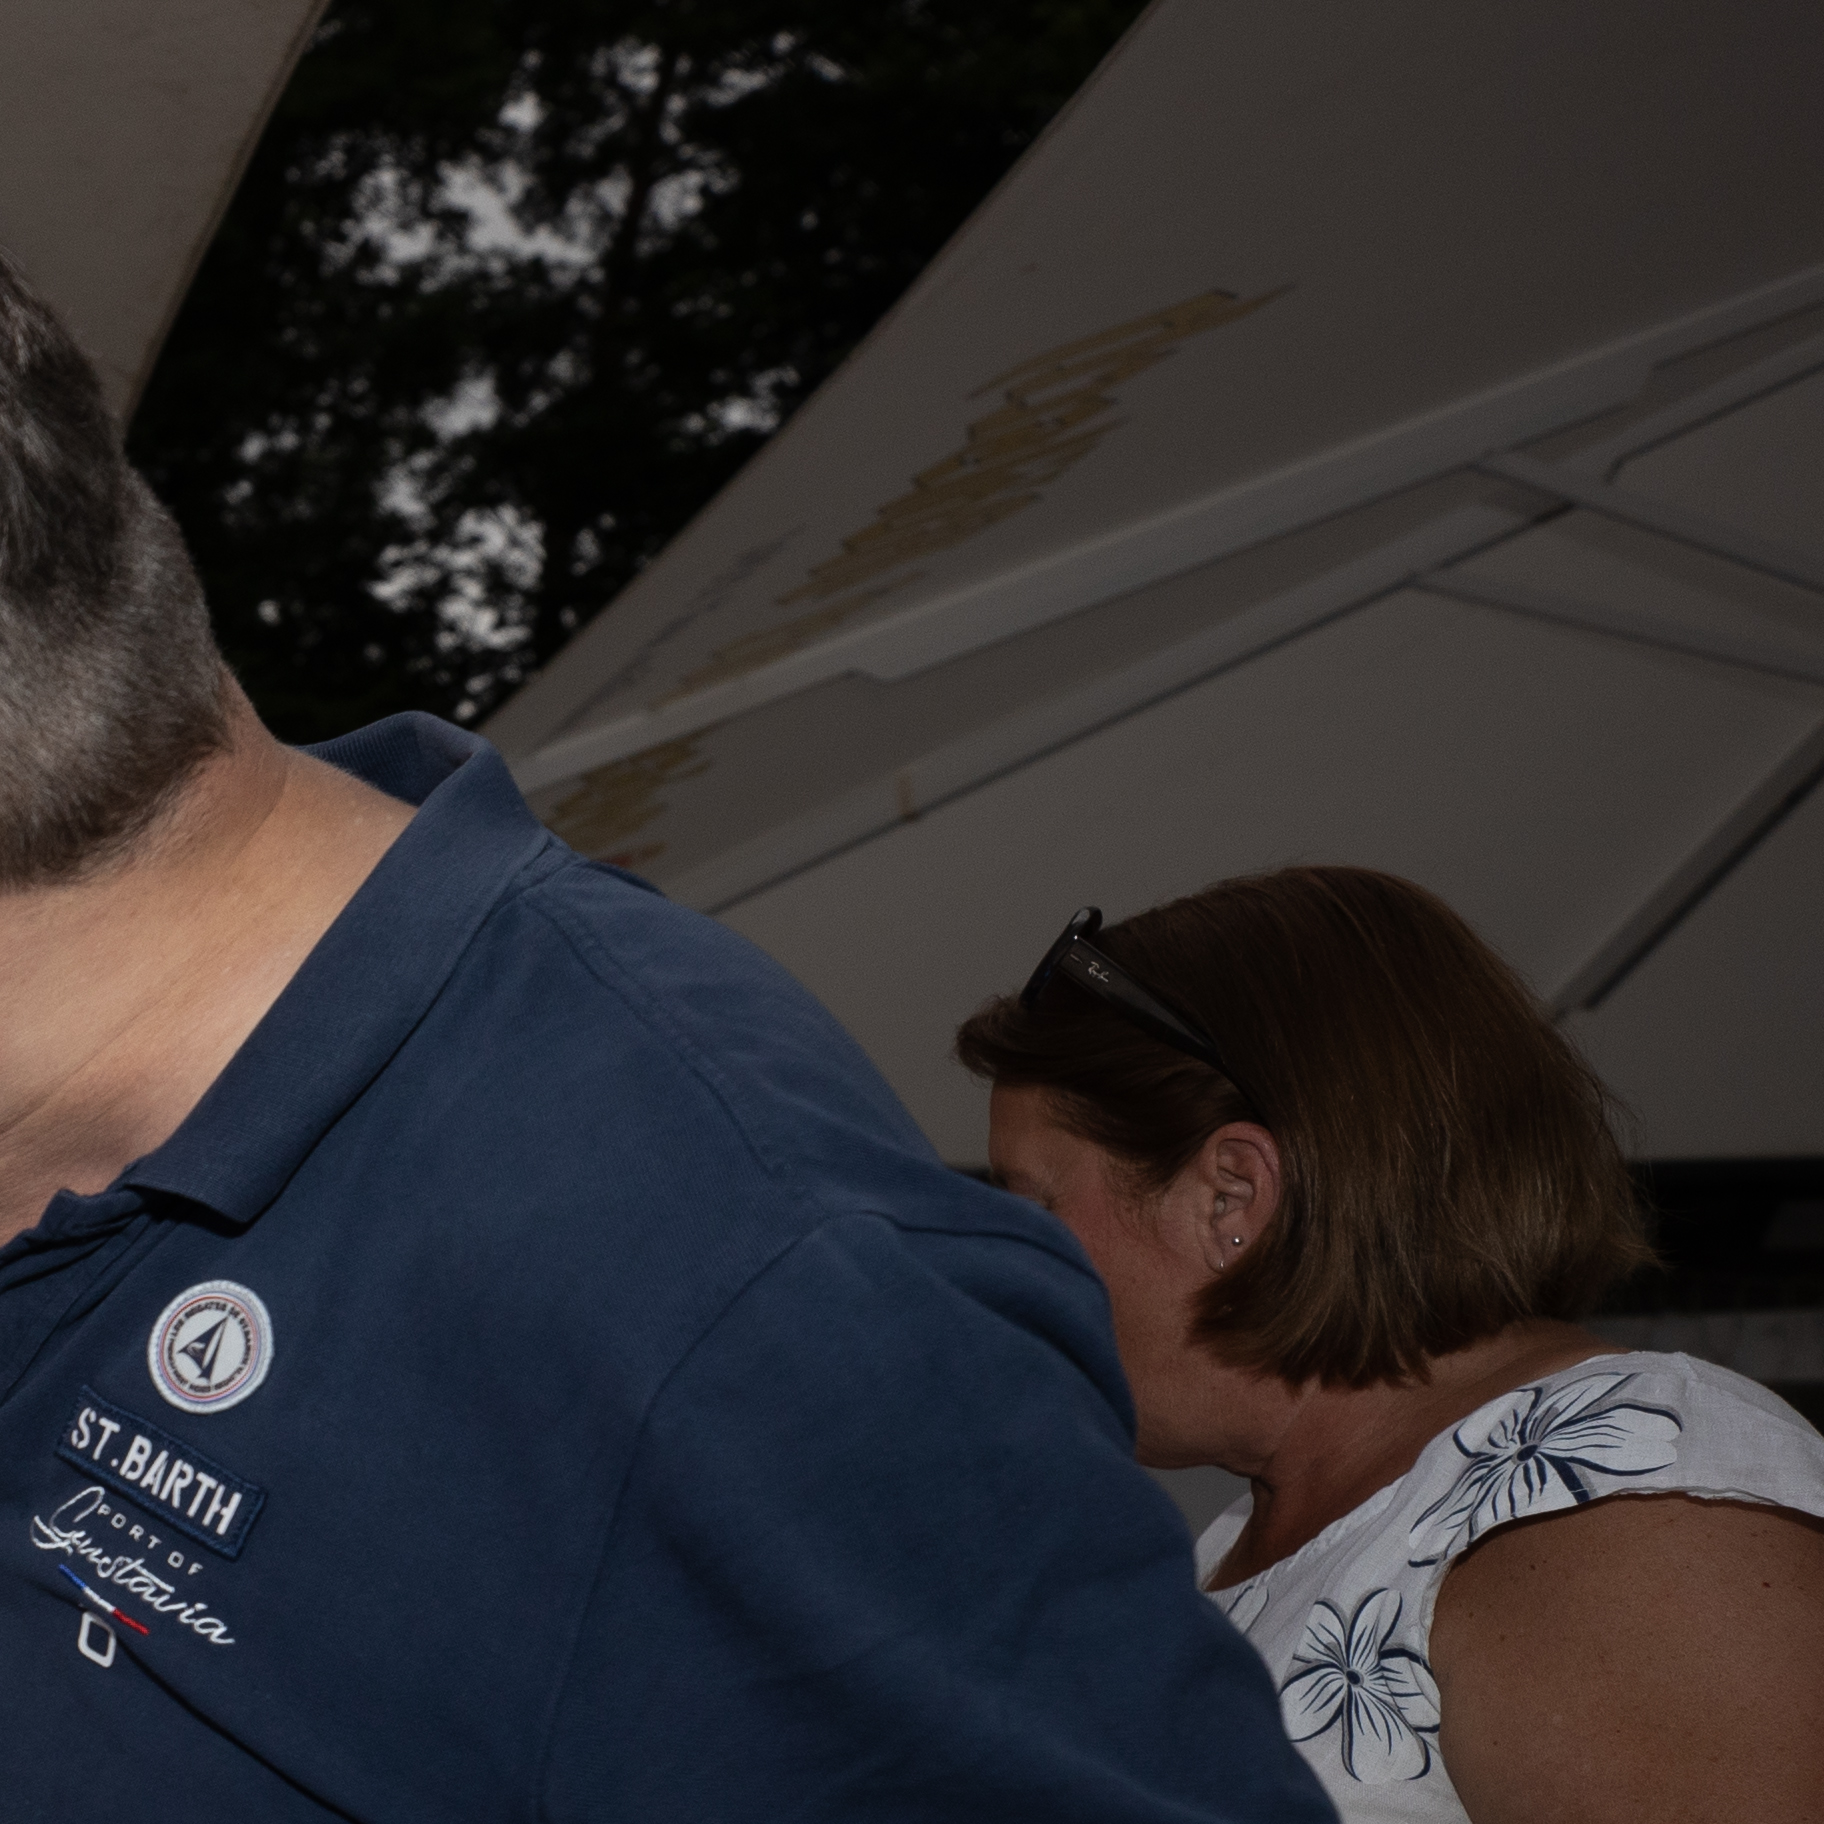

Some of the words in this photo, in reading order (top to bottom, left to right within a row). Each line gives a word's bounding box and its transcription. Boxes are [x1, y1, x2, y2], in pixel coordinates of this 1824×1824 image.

[71, 1406, 243, 1536] ST.BARTH
[30, 1486, 236, 1645] Gustavia
[97, 1504, 162, 1550] PORT
[167, 1551, 204, 1577] OF
